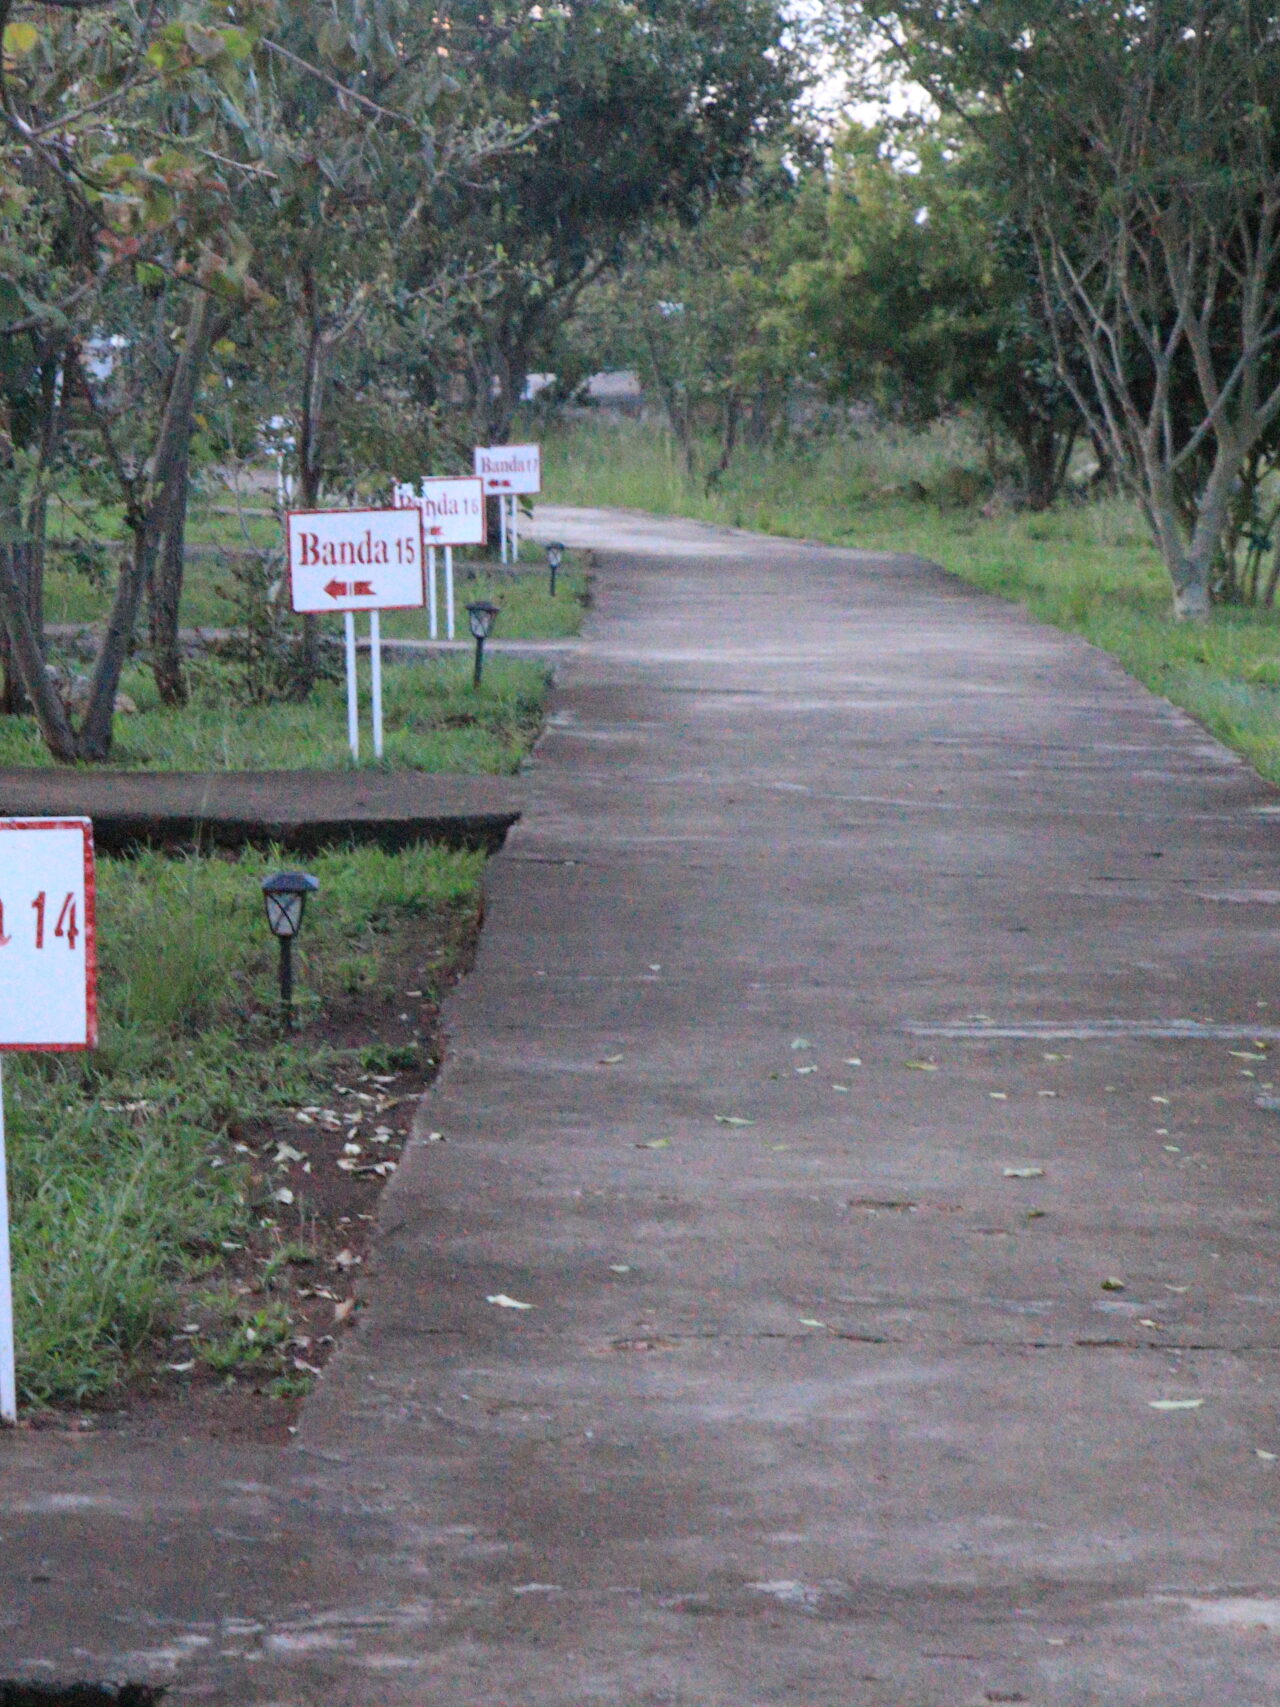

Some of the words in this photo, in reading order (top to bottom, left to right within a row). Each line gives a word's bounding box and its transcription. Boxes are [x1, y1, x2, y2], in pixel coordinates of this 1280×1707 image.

[481, 455, 525, 473] Banda
[298, 528, 388, 566] Banda
[395, 536, 415, 565] 15
[31, 891, 79, 950] 14
